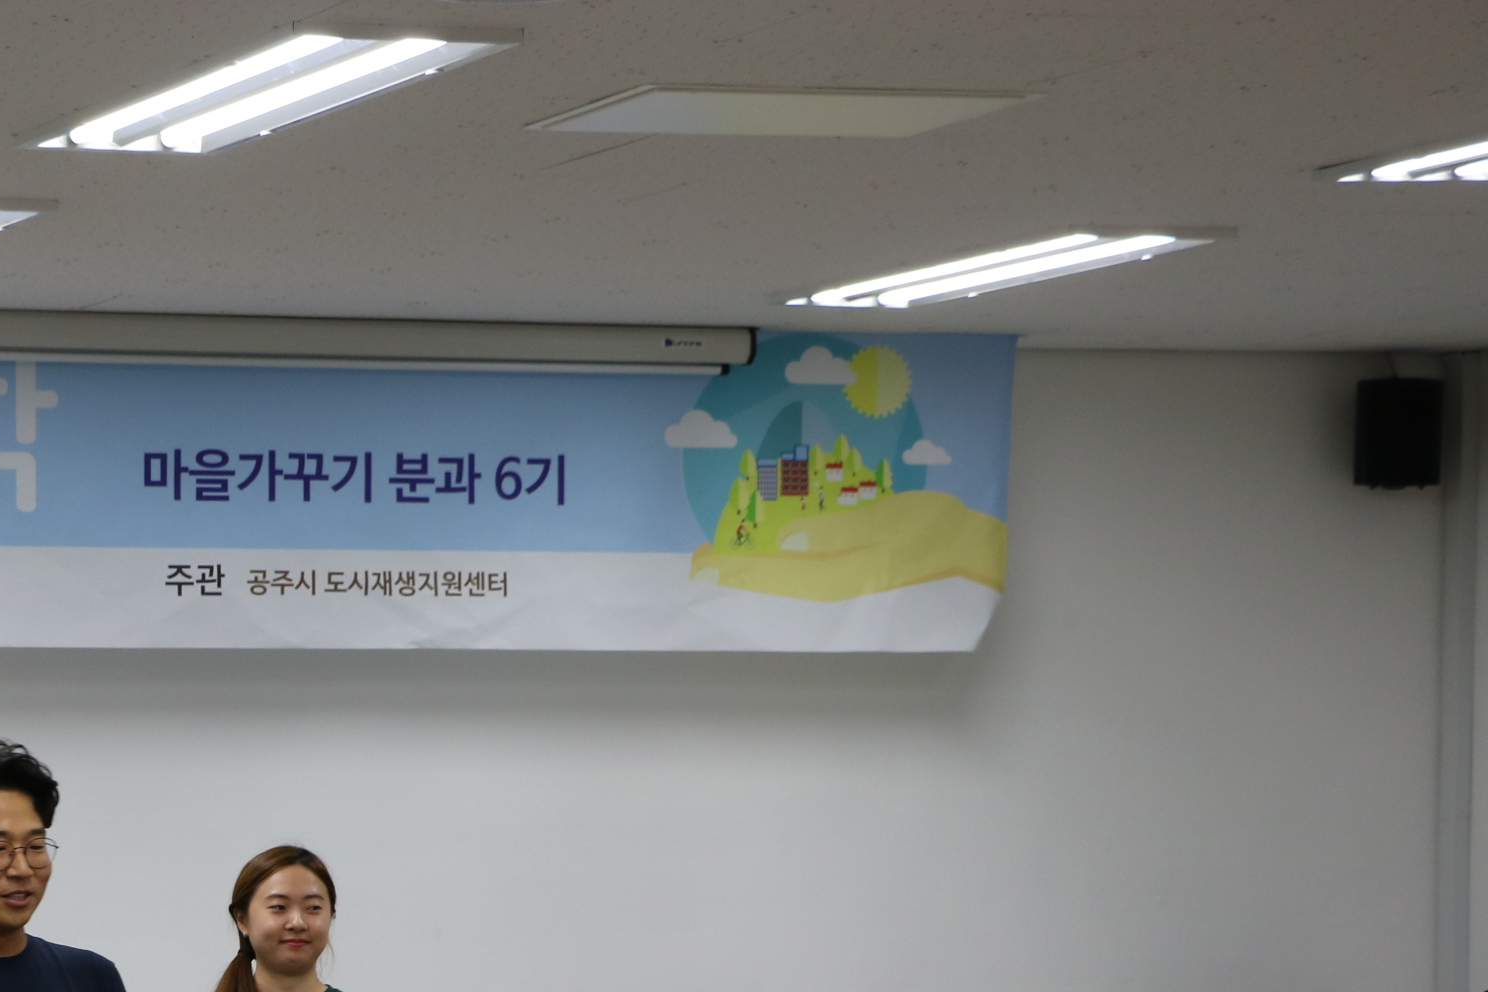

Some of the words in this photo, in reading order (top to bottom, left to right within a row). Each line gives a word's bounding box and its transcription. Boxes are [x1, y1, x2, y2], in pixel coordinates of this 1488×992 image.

[143, 447, 373, 504] 마을가꾸기
[388, 452, 482, 505] 분과
[494, 453, 566, 506] 6기
[164, 563, 226, 597] 주관
[246, 569, 316, 596] 공주시
[323, 569, 508, 598] 도시재생지원센터
